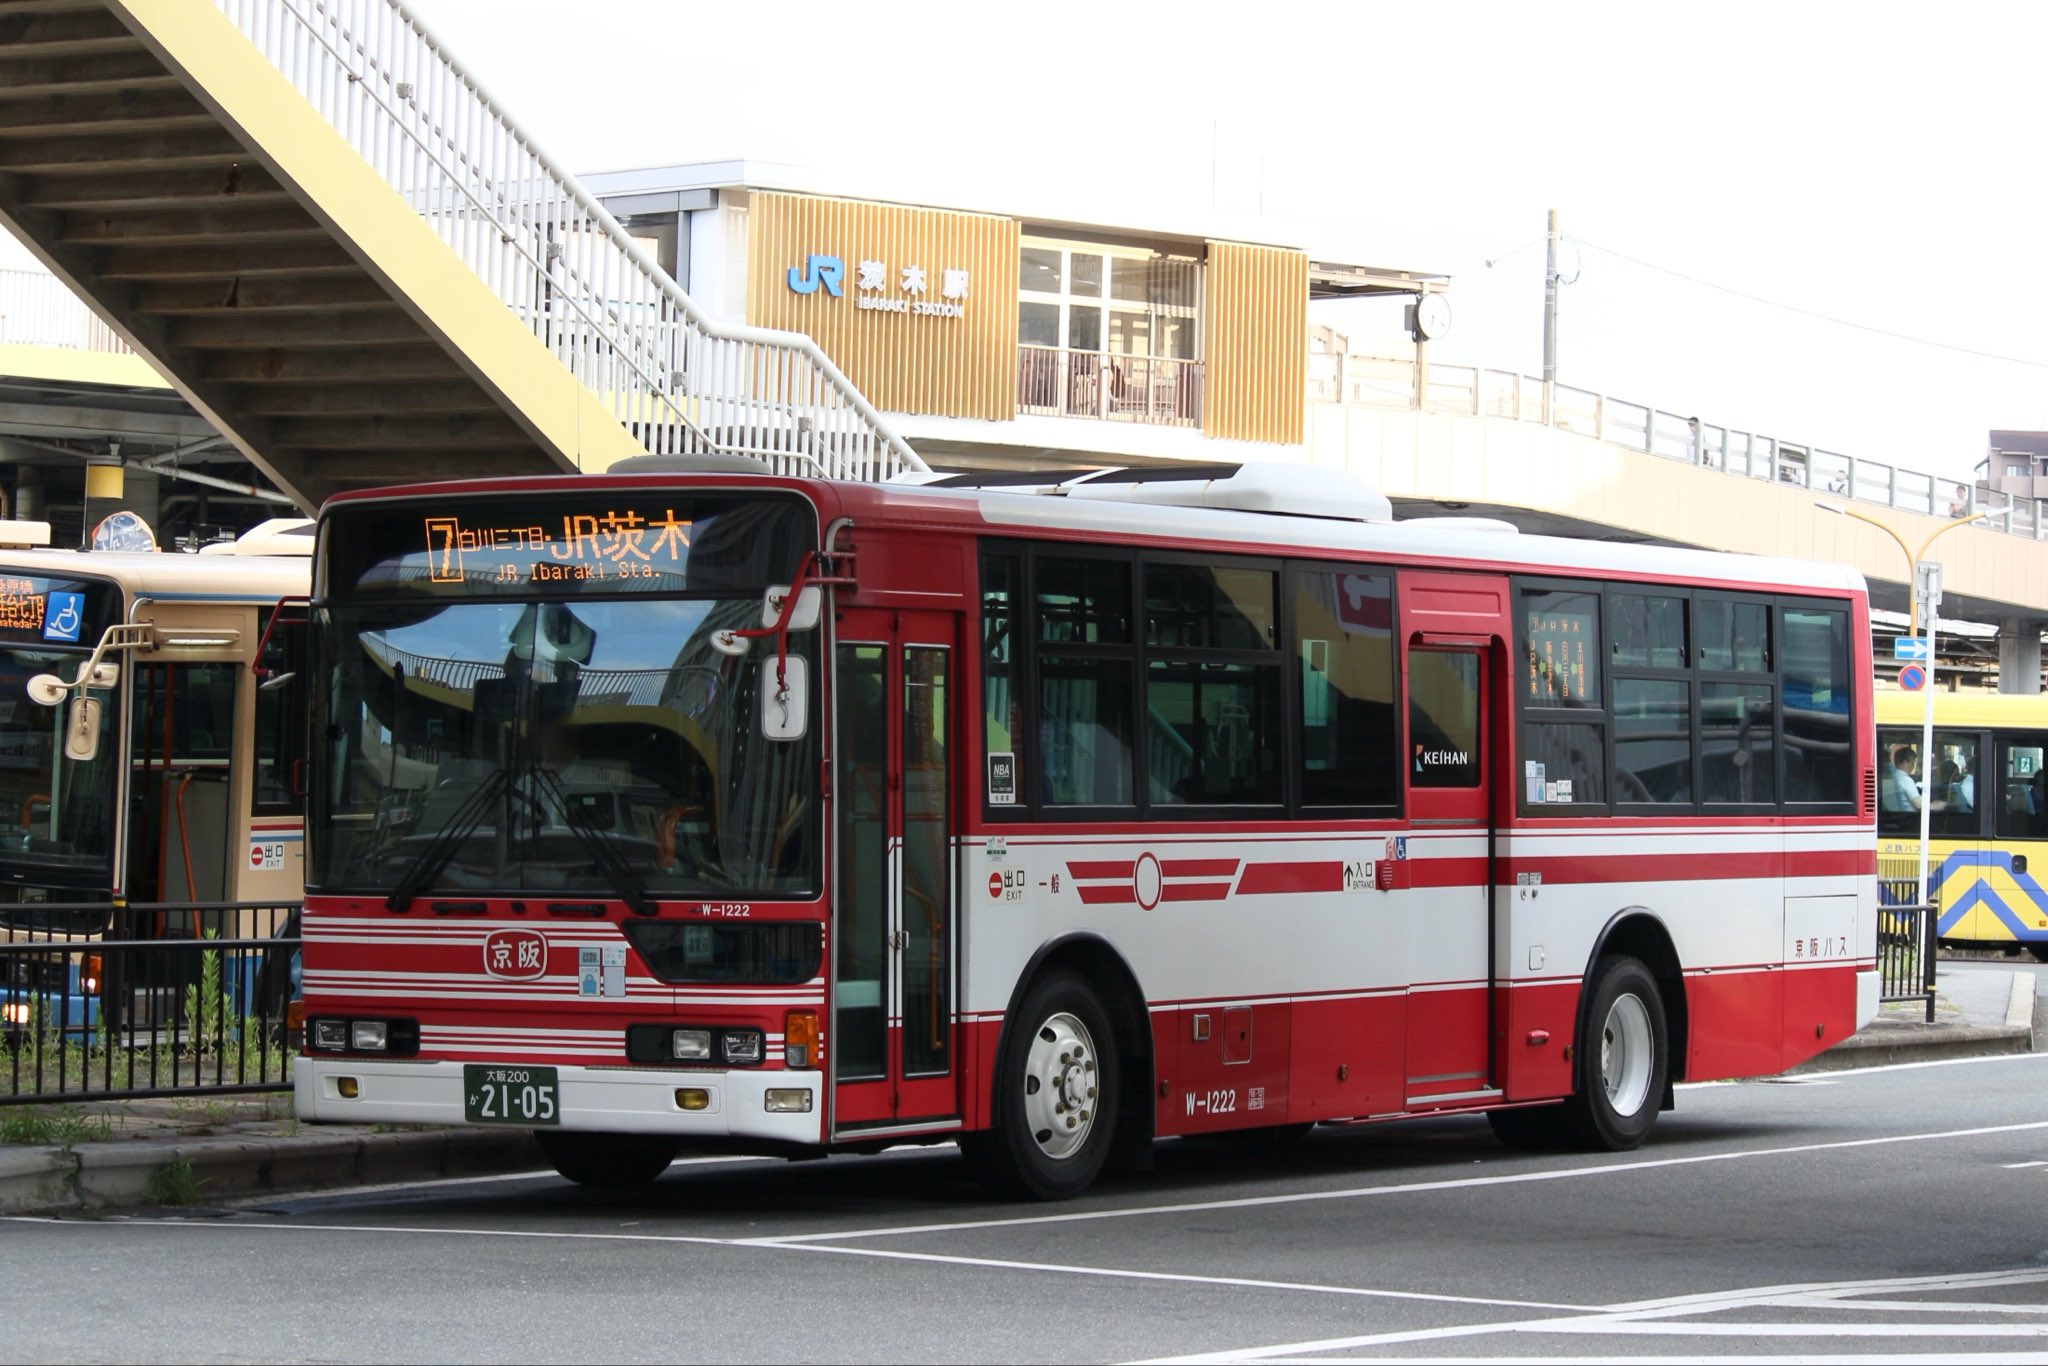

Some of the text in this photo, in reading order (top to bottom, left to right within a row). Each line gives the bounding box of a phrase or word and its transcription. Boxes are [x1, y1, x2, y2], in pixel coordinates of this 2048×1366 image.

[788, 255, 844, 297] JR
[858, 297, 963, 318] IBARAKI STATION
[431, 524, 453, 577] 7
[496, 561, 662, 581] JR Ibaraki Sta.
[993, 764, 1010, 776] NBA
[265, 844, 283, 858] 出口
[1004, 869, 1025, 888] 出口
[1355, 862, 1373, 878] 入口
[1038, 874, 1060, 894] 一般
[1352, 881, 1375, 890] ENTRANCE
[1006, 890, 1023, 901] EXIT
[702, 904, 750, 916] W-1222
[491, 939, 541, 969] 京阪
[1795, 937, 1847, 958] 京阪バス
[469, 1084, 554, 1119] か 21-05
[1186, 1089, 1236, 1116] W-1222
